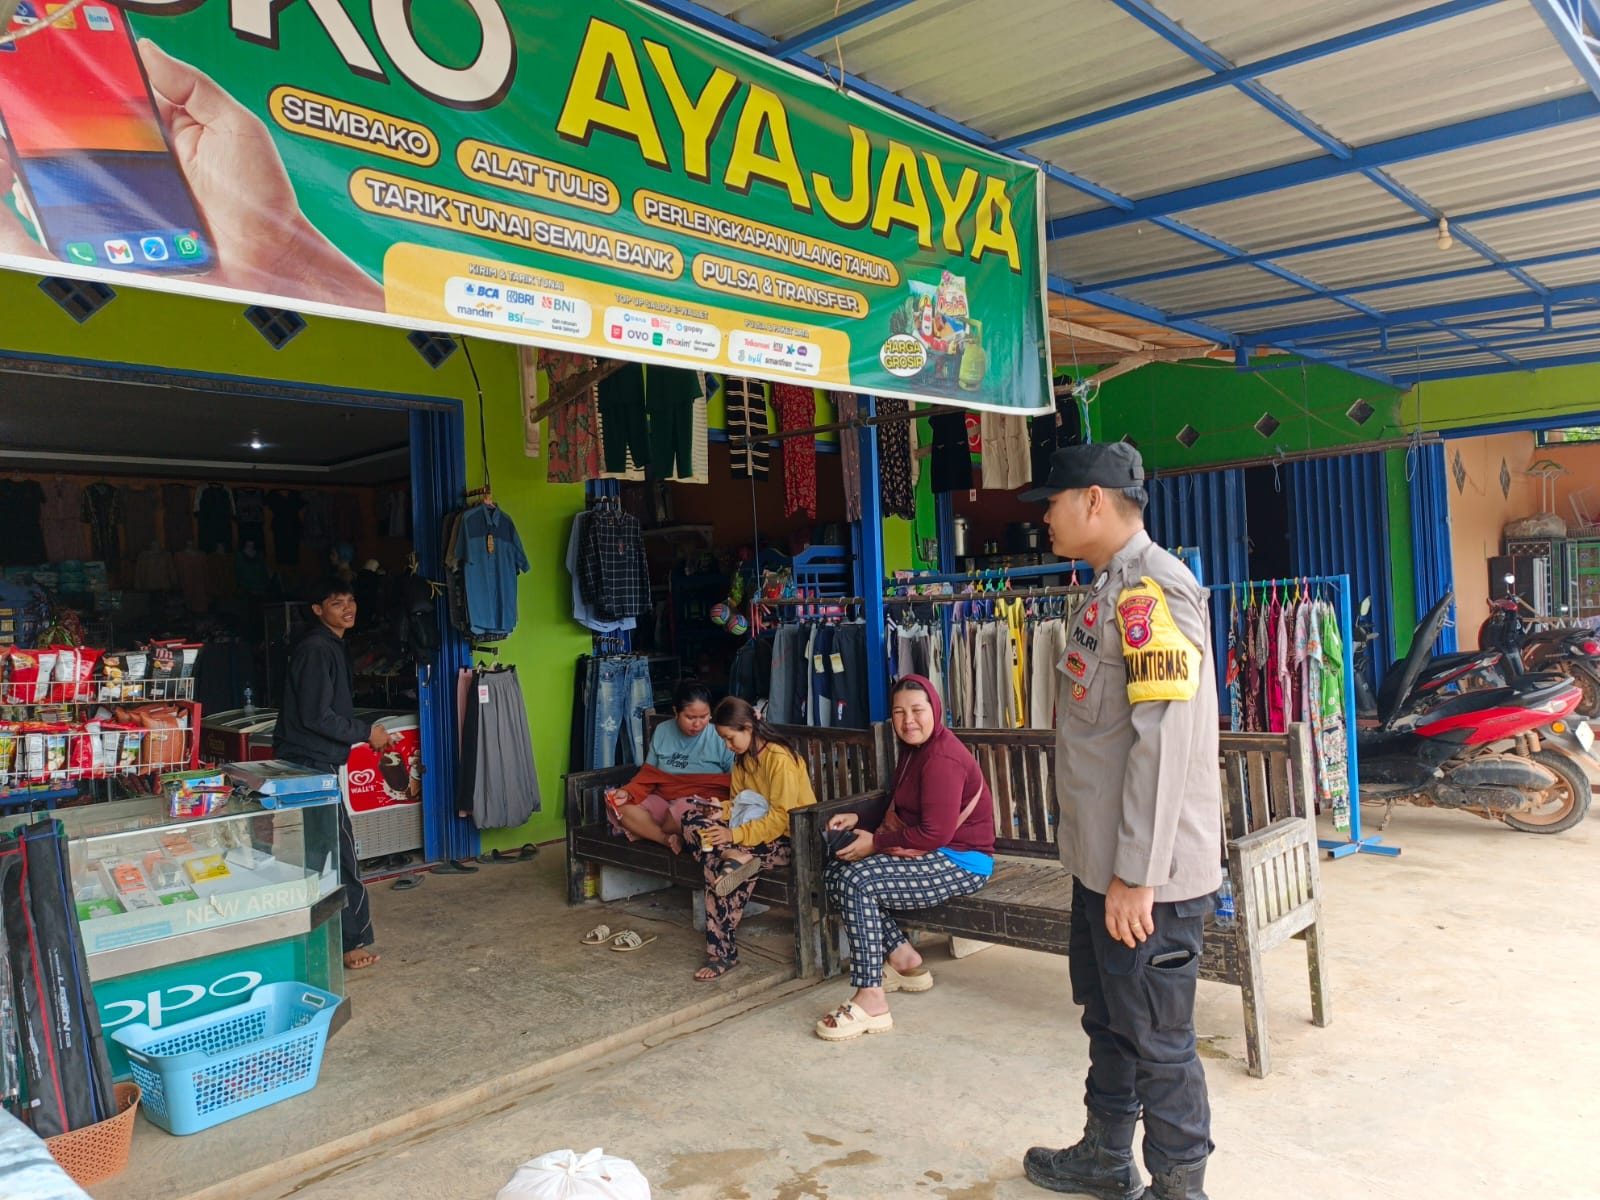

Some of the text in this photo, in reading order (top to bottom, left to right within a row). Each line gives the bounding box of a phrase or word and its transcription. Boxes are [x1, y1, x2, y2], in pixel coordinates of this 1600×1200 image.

[282, 95, 430, 157] SEMBAKO
[555, 15, 812, 213] AYA
[811, 123, 1021, 273] JAYA
[472, 150, 609, 204] ALAT TULIS
[365, 178, 673, 274] TARIK TUNAI SEMUA BANK
[644, 198, 891, 282] PERLENGKAPAN ULANG TAHUN
[469, 263, 498, 280] KIRIM
[508, 271, 536, 287] TARIK
[538, 277, 565, 292] TUNAI
[703, 261, 860, 313] PULSA & TRANSFER
[457, 304, 494, 319] mandiri
[477, 286, 576, 313] BCA BRI BNI
[615, 293, 632, 305] TOP
[627, 329, 649, 341] OVO
[683, 323, 704, 335] gopay
[884, 340, 923, 354] HARGA
[765, 356, 793, 368] smartfren
[884, 355, 925, 370] GROSIR
[1124, 649, 1189, 684] KAMTIBMAS
[351, 785, 375, 794] WALL'S
[185, 899, 240, 928] NEW
